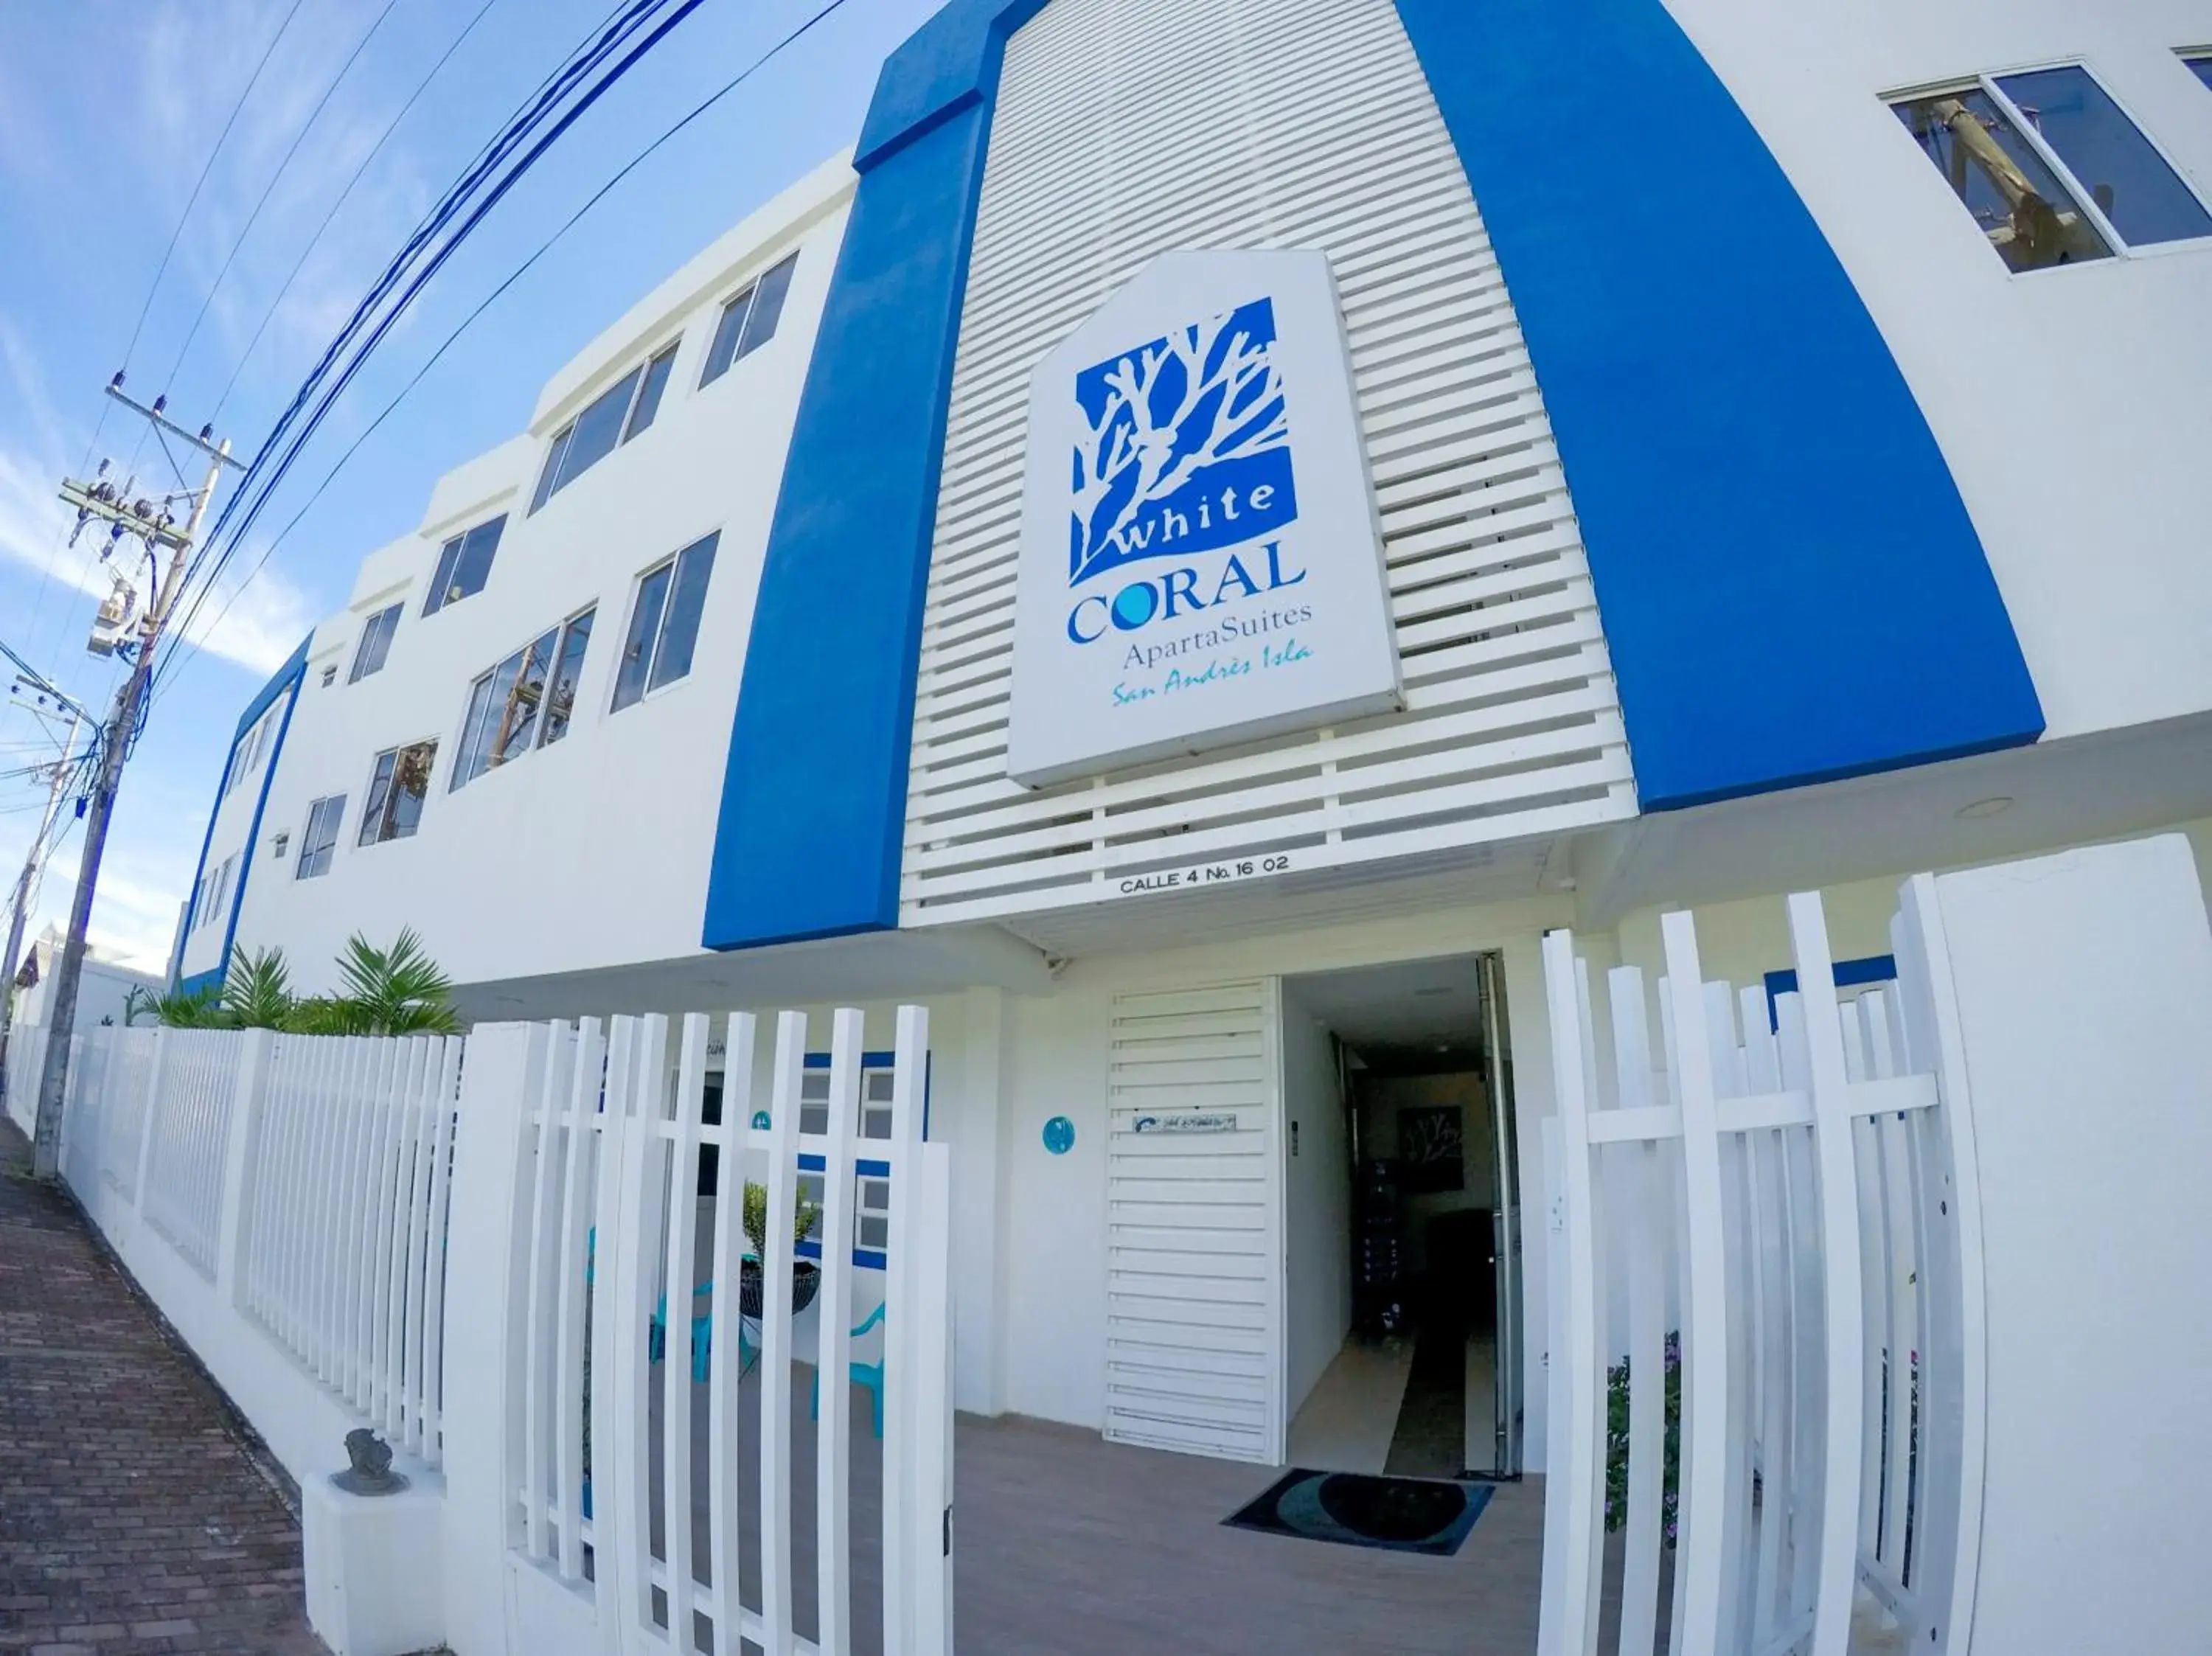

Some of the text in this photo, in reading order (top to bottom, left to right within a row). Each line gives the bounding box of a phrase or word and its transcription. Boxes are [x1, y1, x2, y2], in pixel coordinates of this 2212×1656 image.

[1108, 485, 1274, 554] white
[1067, 540, 1307, 644] CORAL
[1124, 604, 1312, 669] ApartaSuites
[1112, 681, 1155, 707] San
[1263, 639, 1314, 668] Isla
[1120, 873, 1180, 894] CALLE
[1186, 870, 1198, 883] 4
[1236, 862, 1253, 876] 16
[1263, 856, 1289, 872] 02
